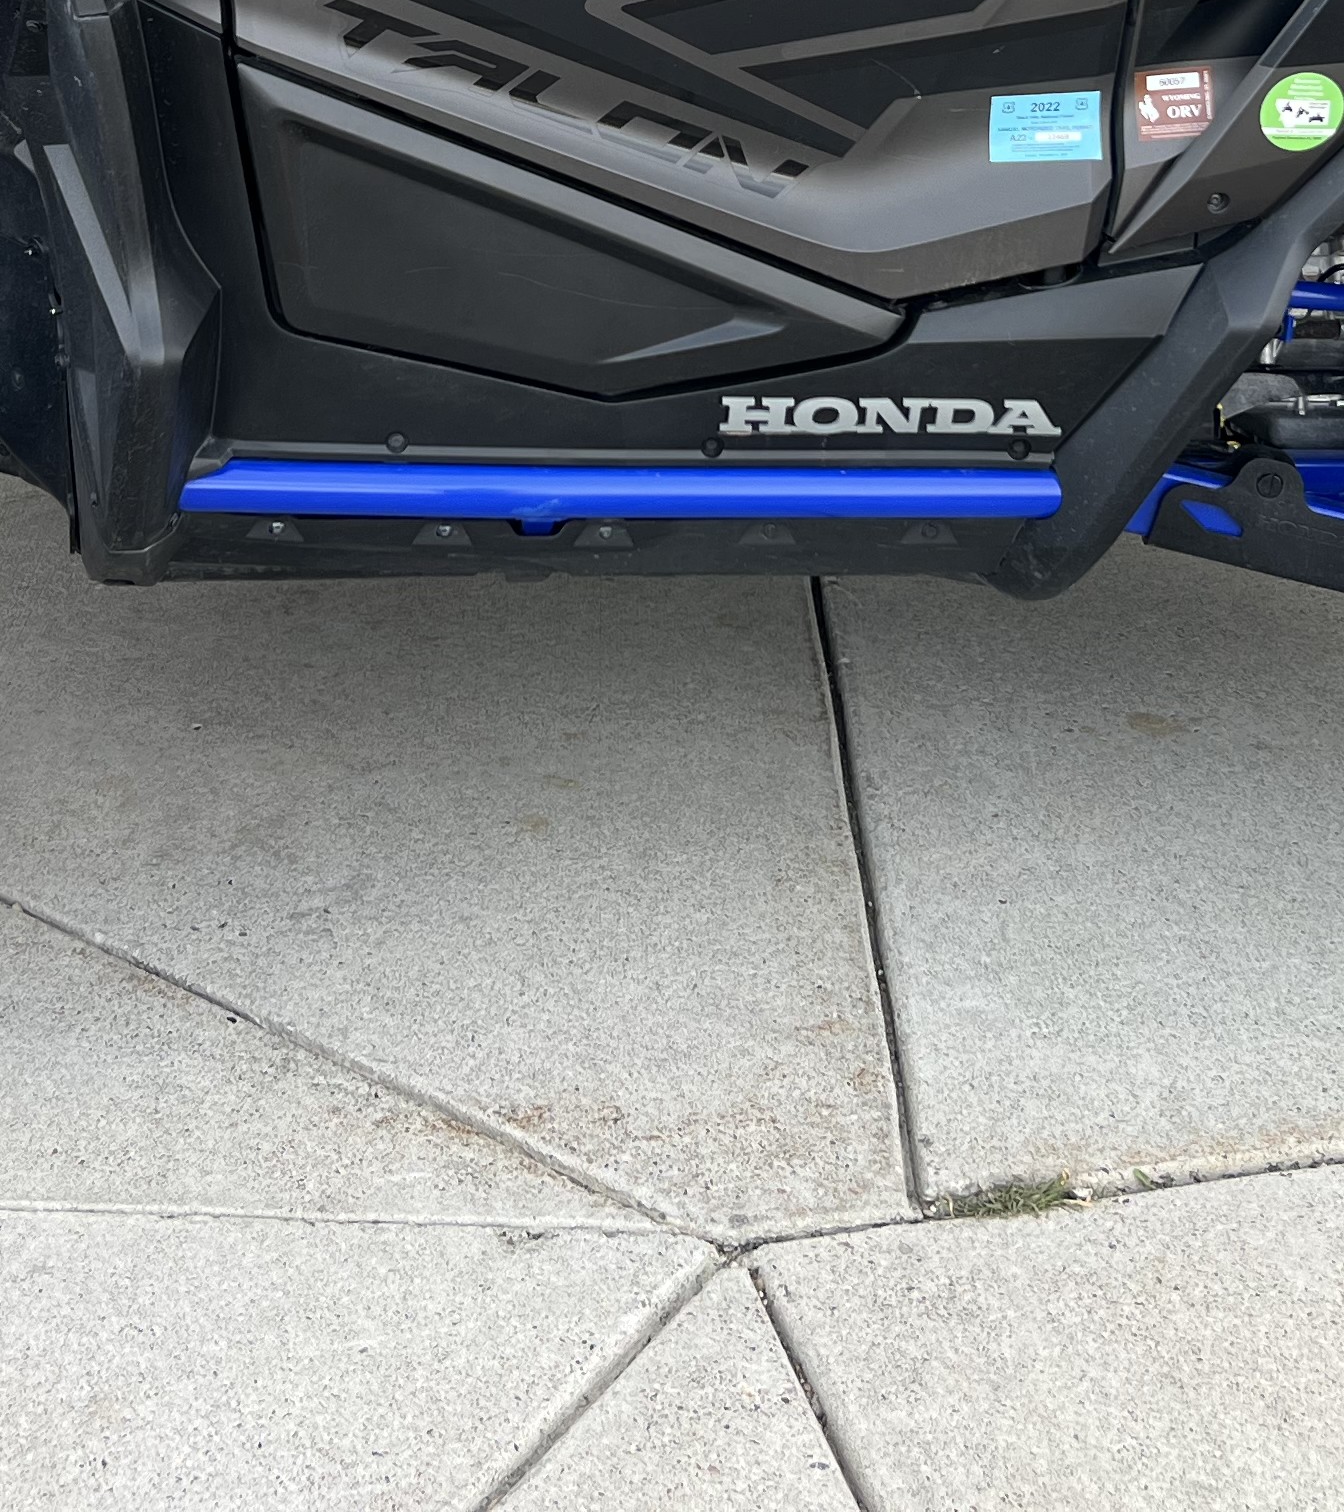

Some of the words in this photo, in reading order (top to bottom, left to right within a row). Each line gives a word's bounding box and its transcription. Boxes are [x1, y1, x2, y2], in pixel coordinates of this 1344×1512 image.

[1030, 101, 1061, 113] 2022
[1166, 103, 1202, 119] ORV
[718, 395, 1062, 436] HONDA
